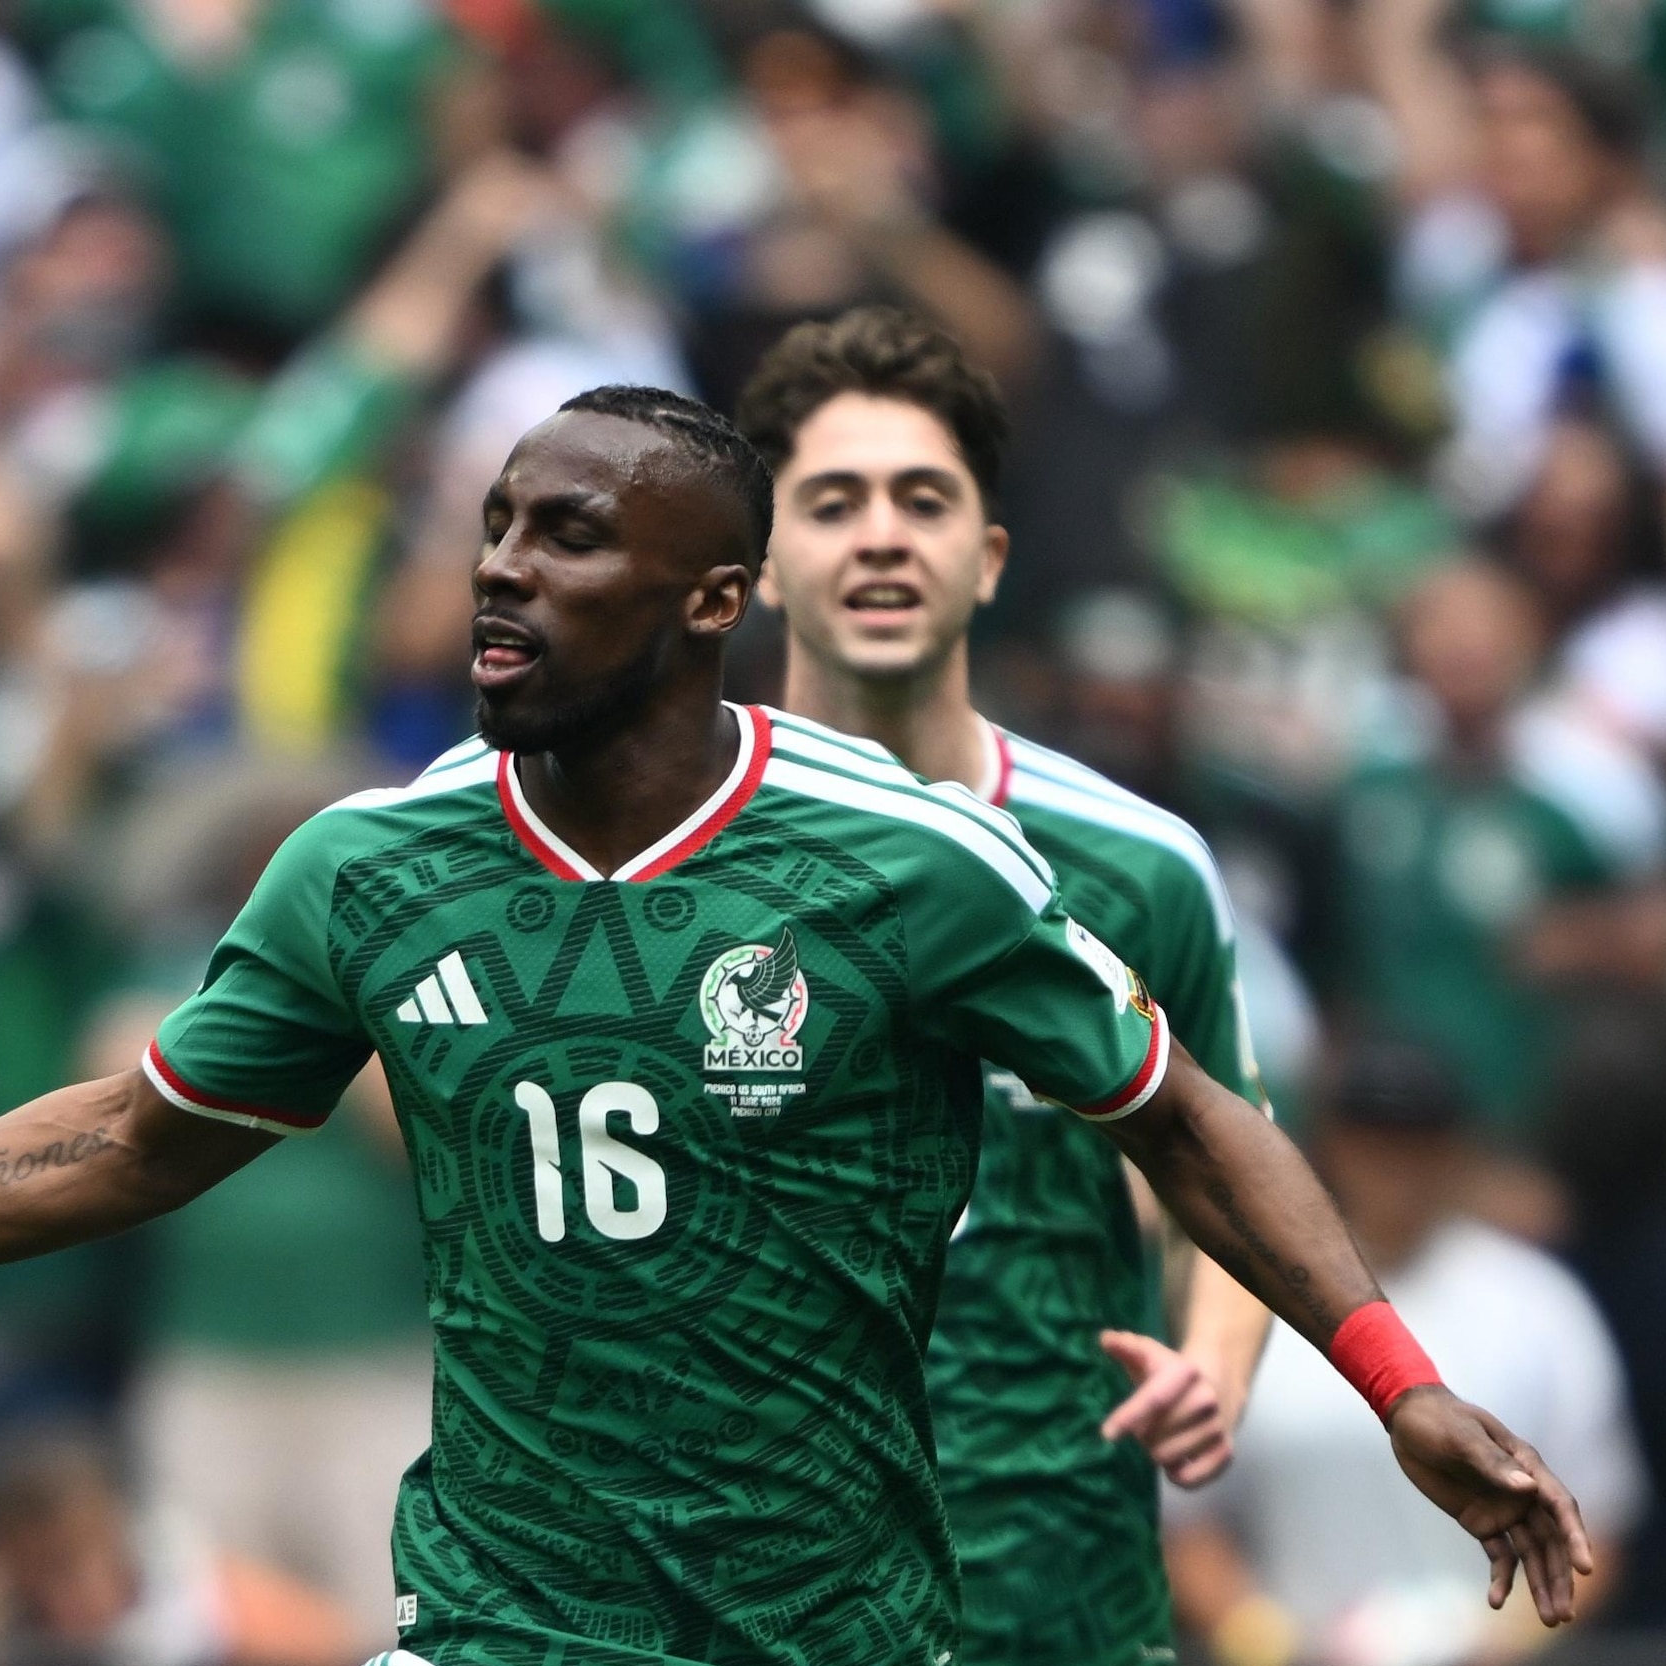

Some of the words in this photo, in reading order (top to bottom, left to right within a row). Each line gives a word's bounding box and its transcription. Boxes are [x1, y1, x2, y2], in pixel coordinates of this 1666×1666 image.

[707, 1045, 800, 1068] MÉXICO
[751, 1084, 777, 1095] SOUTH
[514, 1080, 668, 1243] 16
